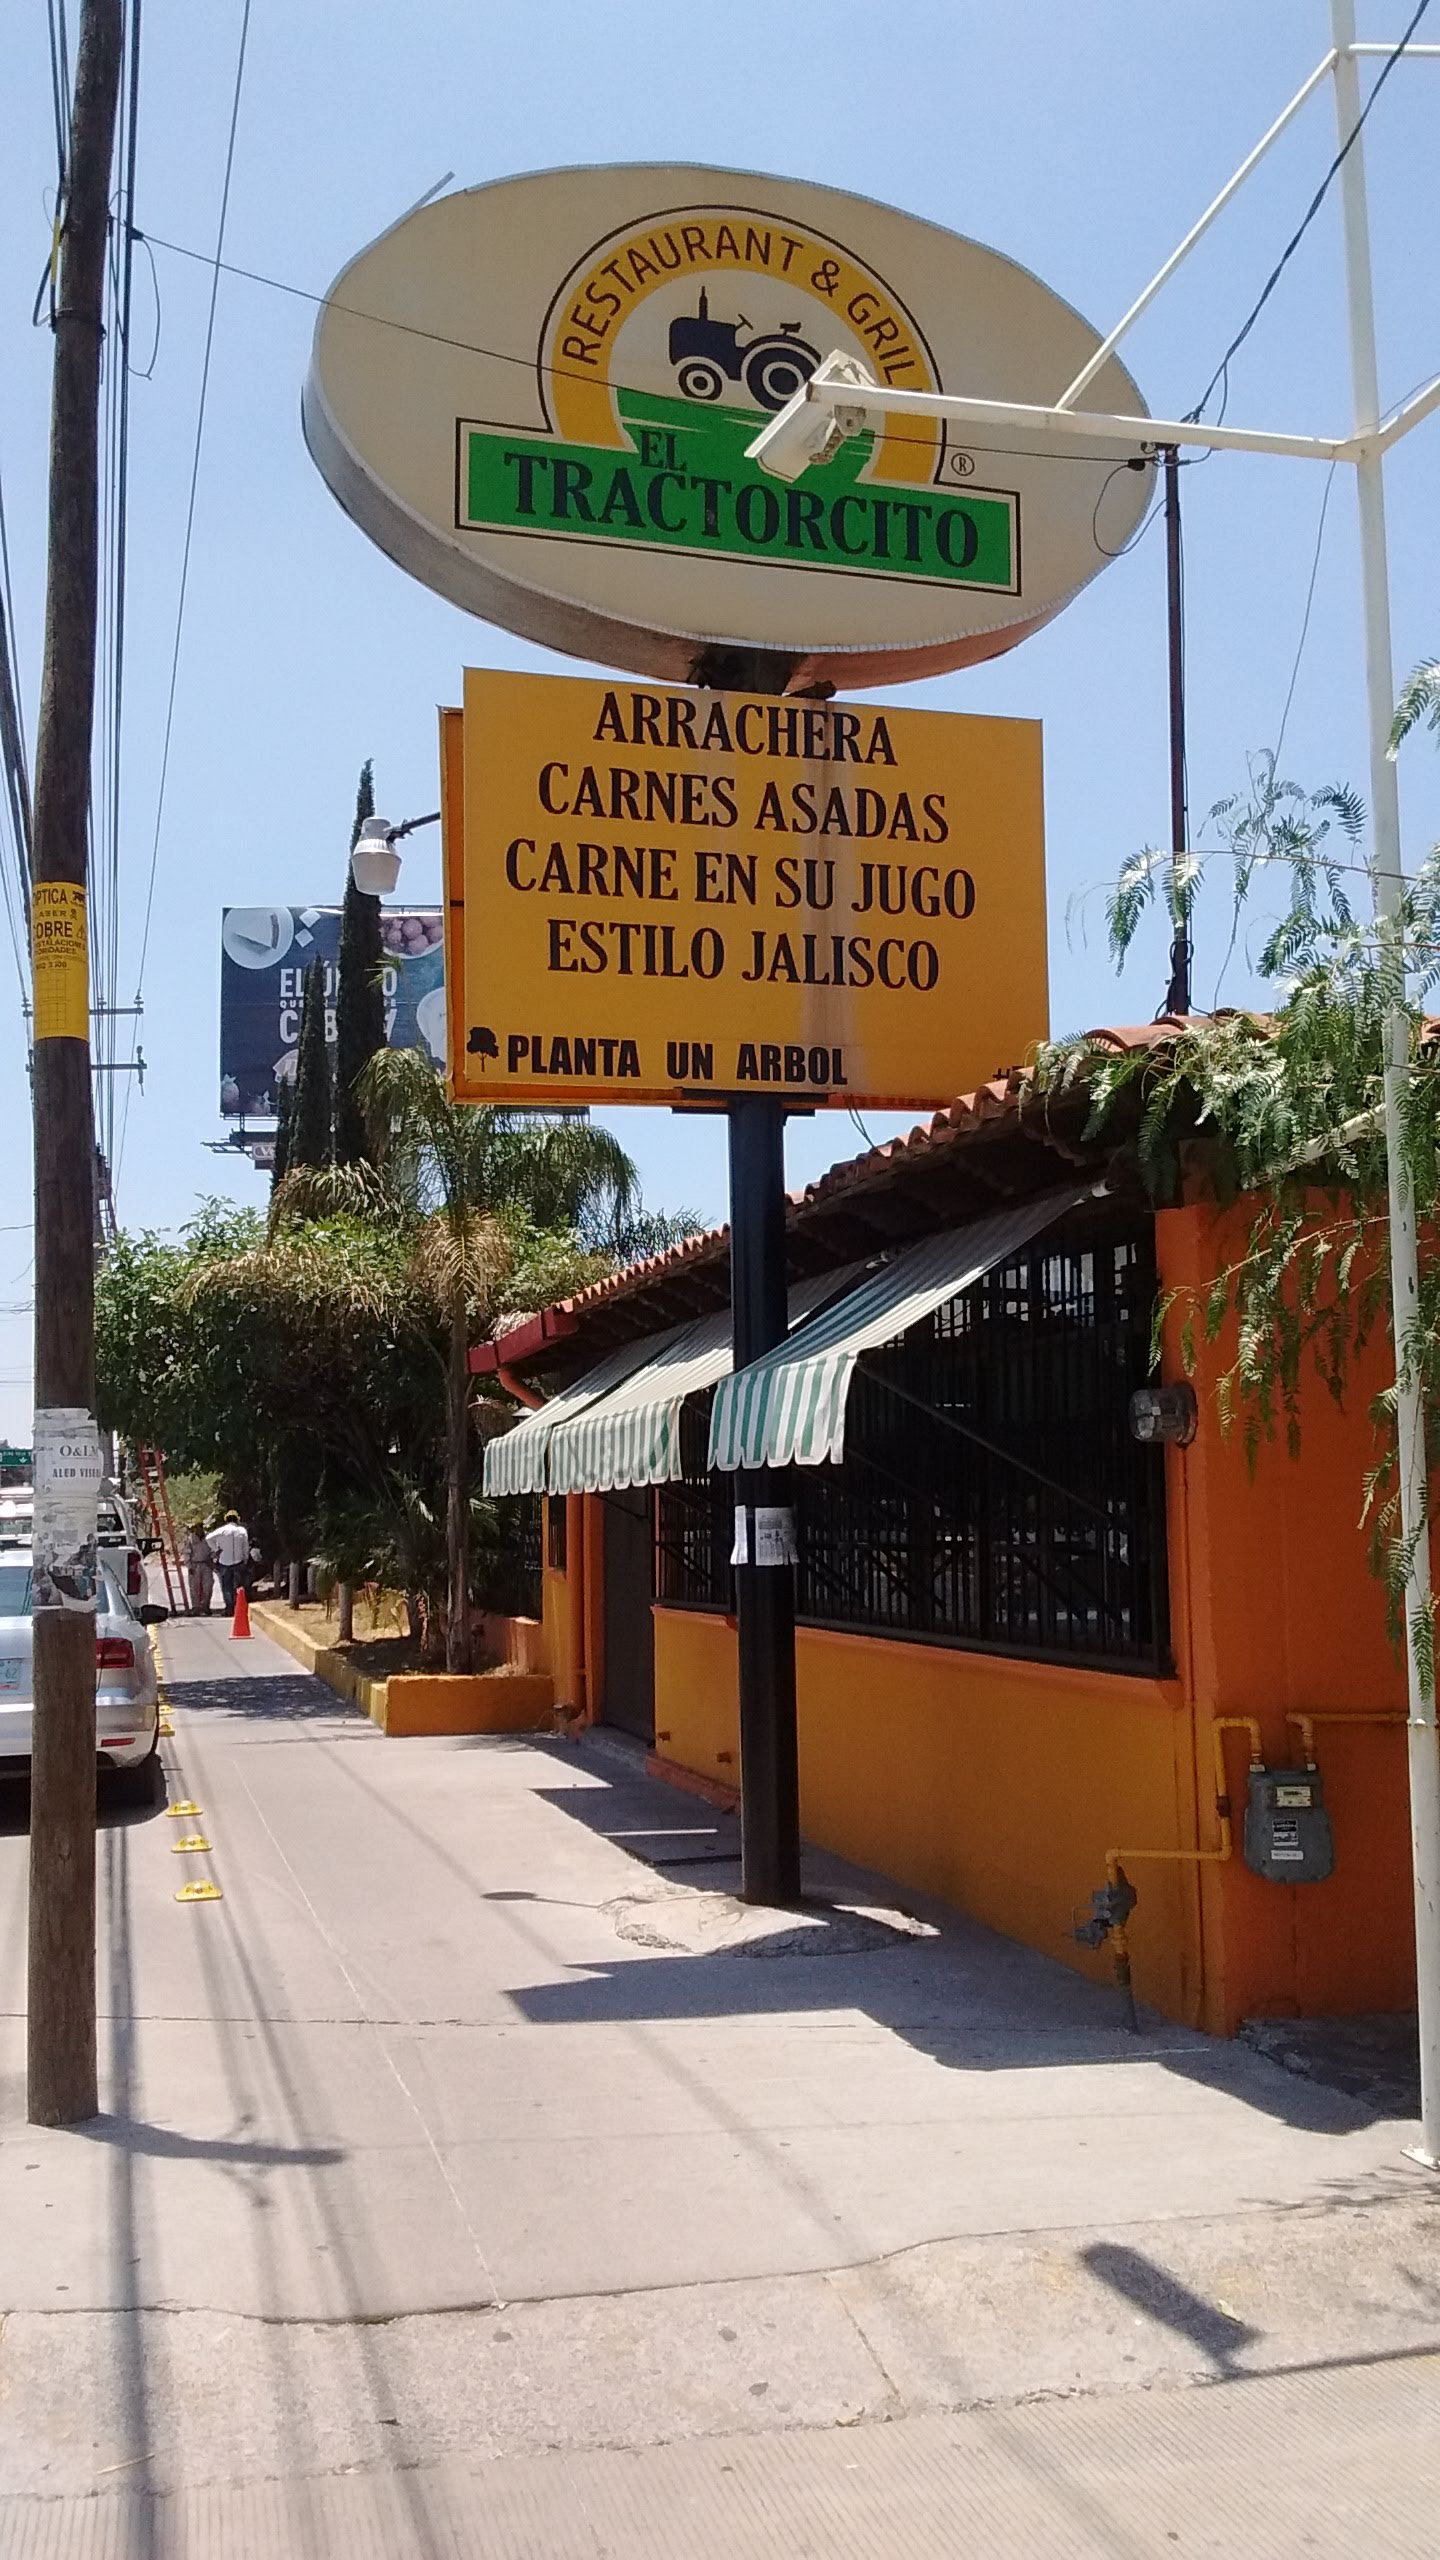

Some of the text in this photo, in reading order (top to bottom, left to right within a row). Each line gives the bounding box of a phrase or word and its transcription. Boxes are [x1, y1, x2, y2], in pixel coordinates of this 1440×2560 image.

[562, 224, 923, 392] RESTAURANT & GRIL
[639, 430, 688, 473] EL
[503, 451, 979, 569] TRACTORCITO
[592, 691, 898, 766] ARRACHERA
[537, 761, 950, 844] CARNES ASADAS
[505, 837, 977, 920] CARNE EN SU JUGO
[547, 918, 941, 991] ESTILO JALISCO
[507, 1034, 848, 1086] PLANTA UN ARBOL
